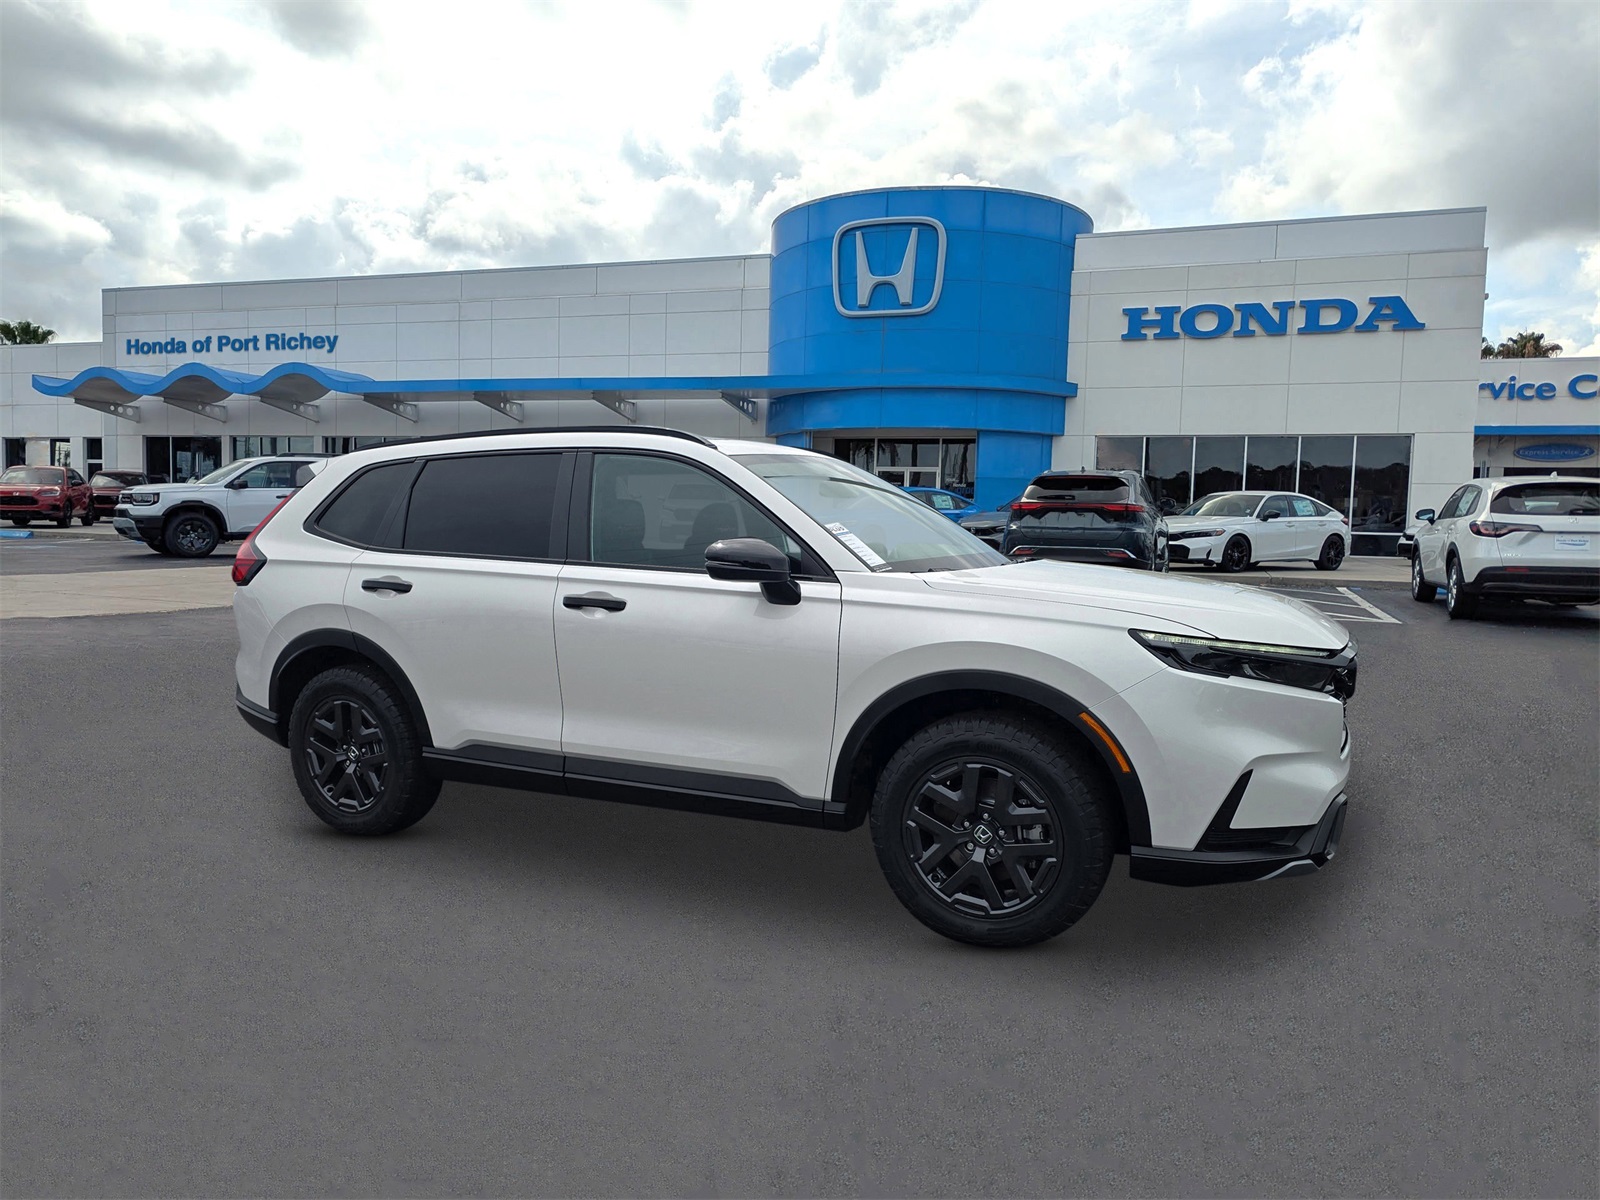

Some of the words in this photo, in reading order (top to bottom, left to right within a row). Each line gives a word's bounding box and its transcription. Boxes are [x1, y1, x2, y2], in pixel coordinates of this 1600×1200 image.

[1121, 295, 1426, 341] HONDA
[126, 337, 187, 355] Honda
[191, 336, 212, 352] of
[217, 335, 259, 352] Port
[265, 332, 339, 353] Richey
[1567, 373, 1600, 400] C
